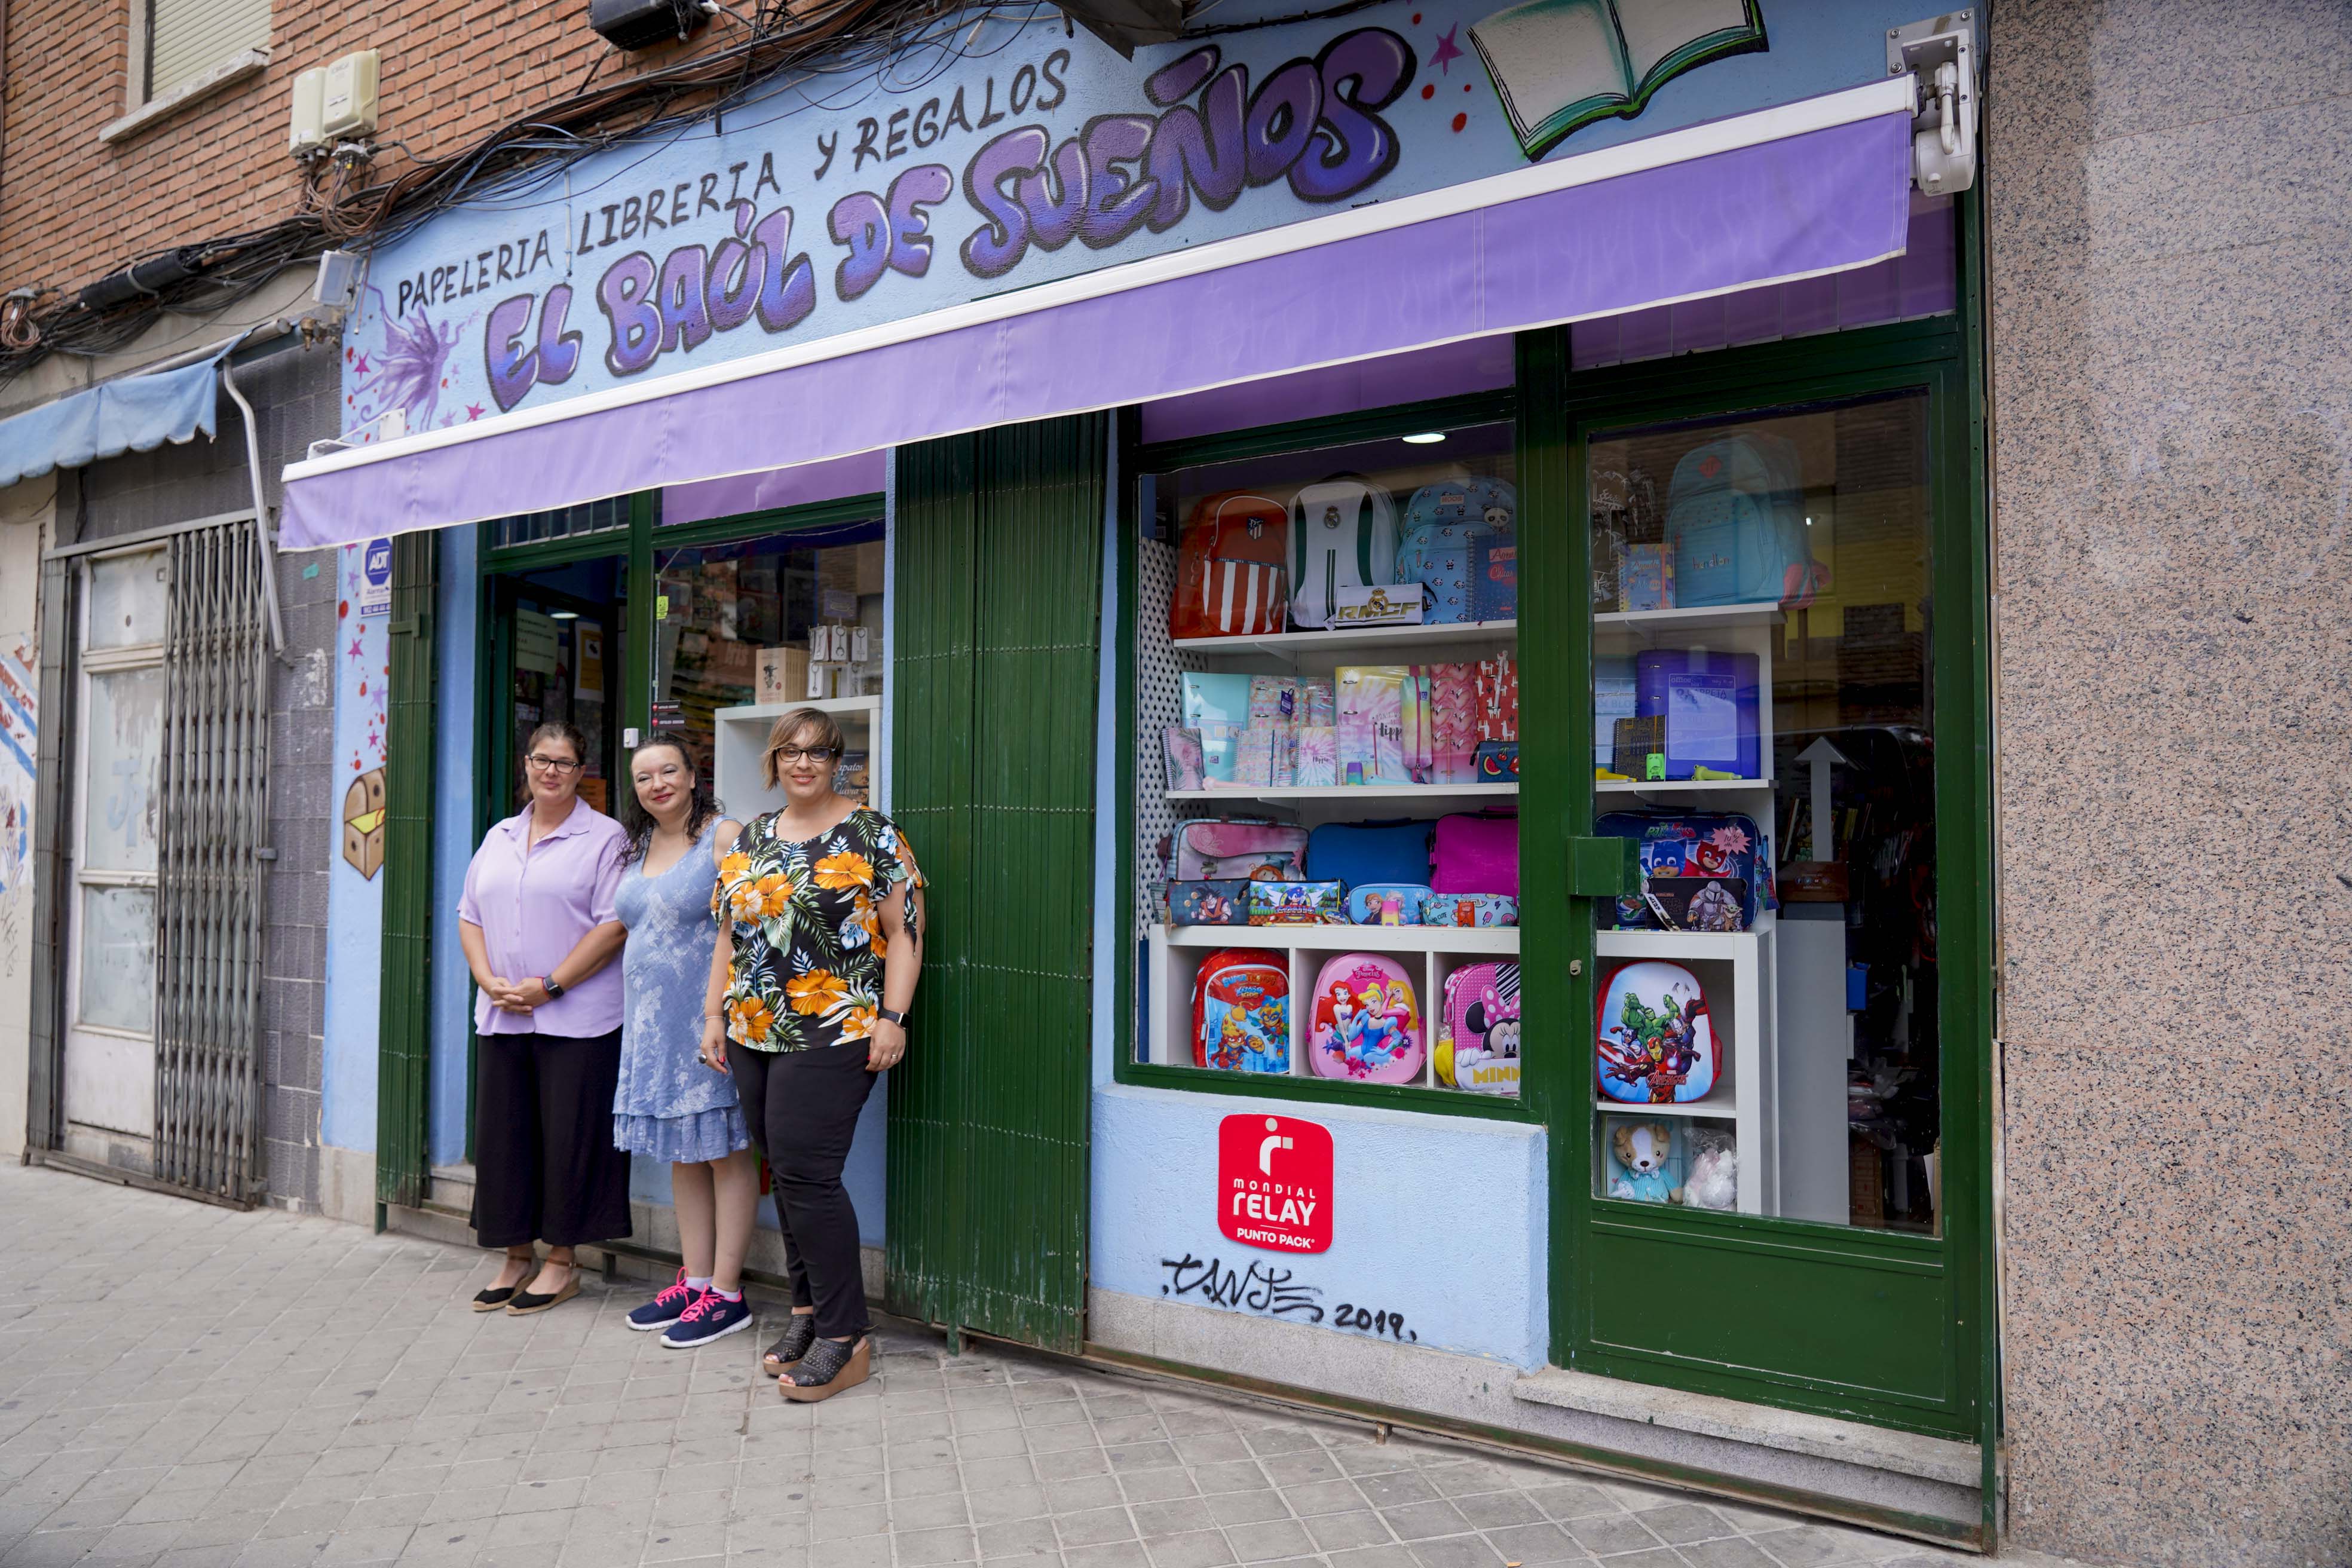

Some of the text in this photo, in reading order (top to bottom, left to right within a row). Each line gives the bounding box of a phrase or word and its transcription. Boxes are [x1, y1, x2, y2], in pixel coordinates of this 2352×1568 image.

[399, 229, 553, 320] PAPELERIA
[852, 48, 1071, 172] REGALOS
[484, 282, 583, 414] EL
[827, 162, 953, 301] DE
[960, 26, 1417, 279] SUEÑOS
[369, 550, 390, 570] ADT
[838, 762, 865, 776] apatos
[1236, 1227, 1277, 1244] PUNTO
